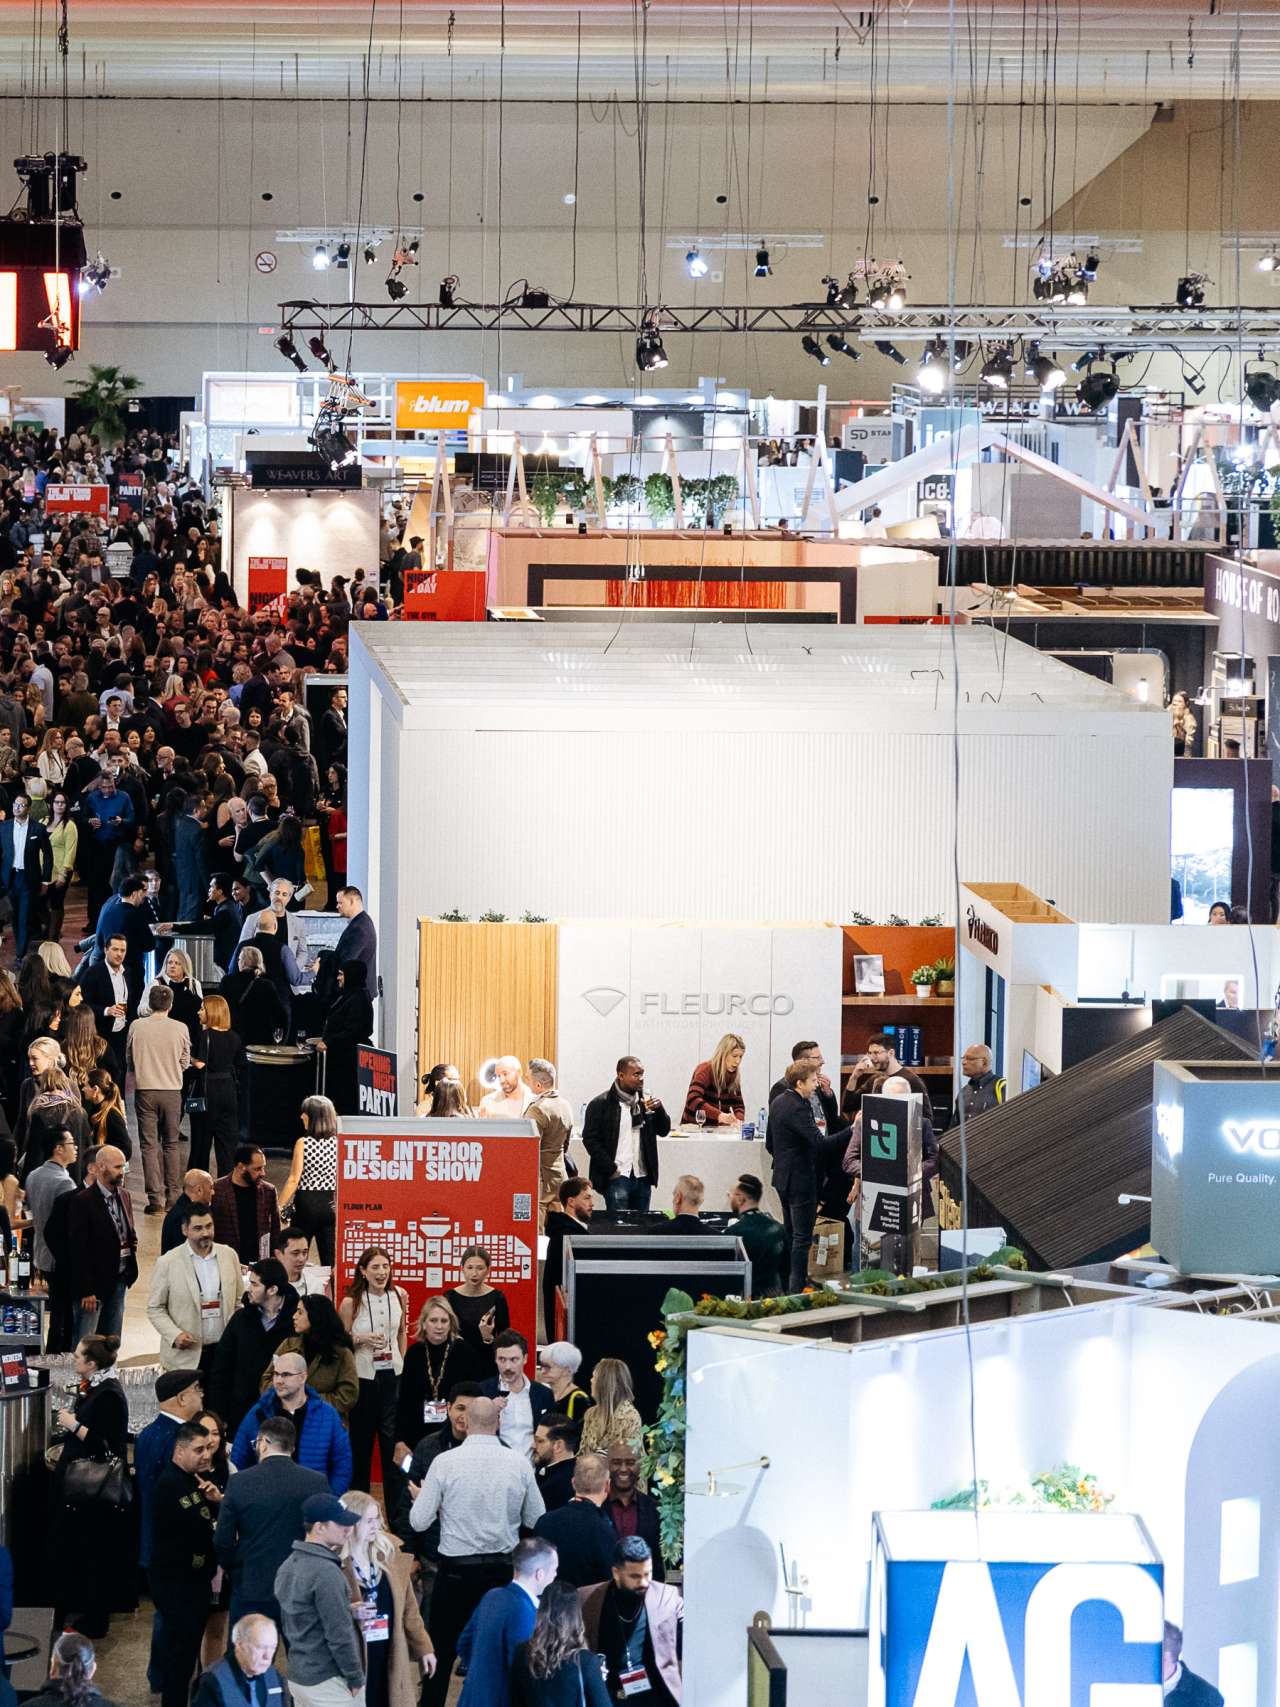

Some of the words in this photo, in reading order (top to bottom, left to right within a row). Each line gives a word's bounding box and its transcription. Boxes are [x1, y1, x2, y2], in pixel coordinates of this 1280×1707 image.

[414, 395, 470, 413] blum
[980, 400, 1108, 416] WINDWS
[850, 429, 868, 440] SD
[325, 470, 348, 481] ART
[119, 485, 143, 496] PARTY
[417, 583, 438, 594] DAY
[1215, 568, 1248, 611] HOUSE
[1248, 579, 1263, 614] OF
[639, 992, 795, 1016] FLEURCO
[360, 1084, 396, 1117] PARTY
[344, 1140, 382, 1160] THE
[393, 1141, 483, 1162] INTERIOR
[343, 1160, 413, 1181] DESIGN
[425, 1161, 483, 1182] SHOW
[1208, 1173, 1233, 1183] Pure
[1236, 1173, 1277, 1185] Quality.
